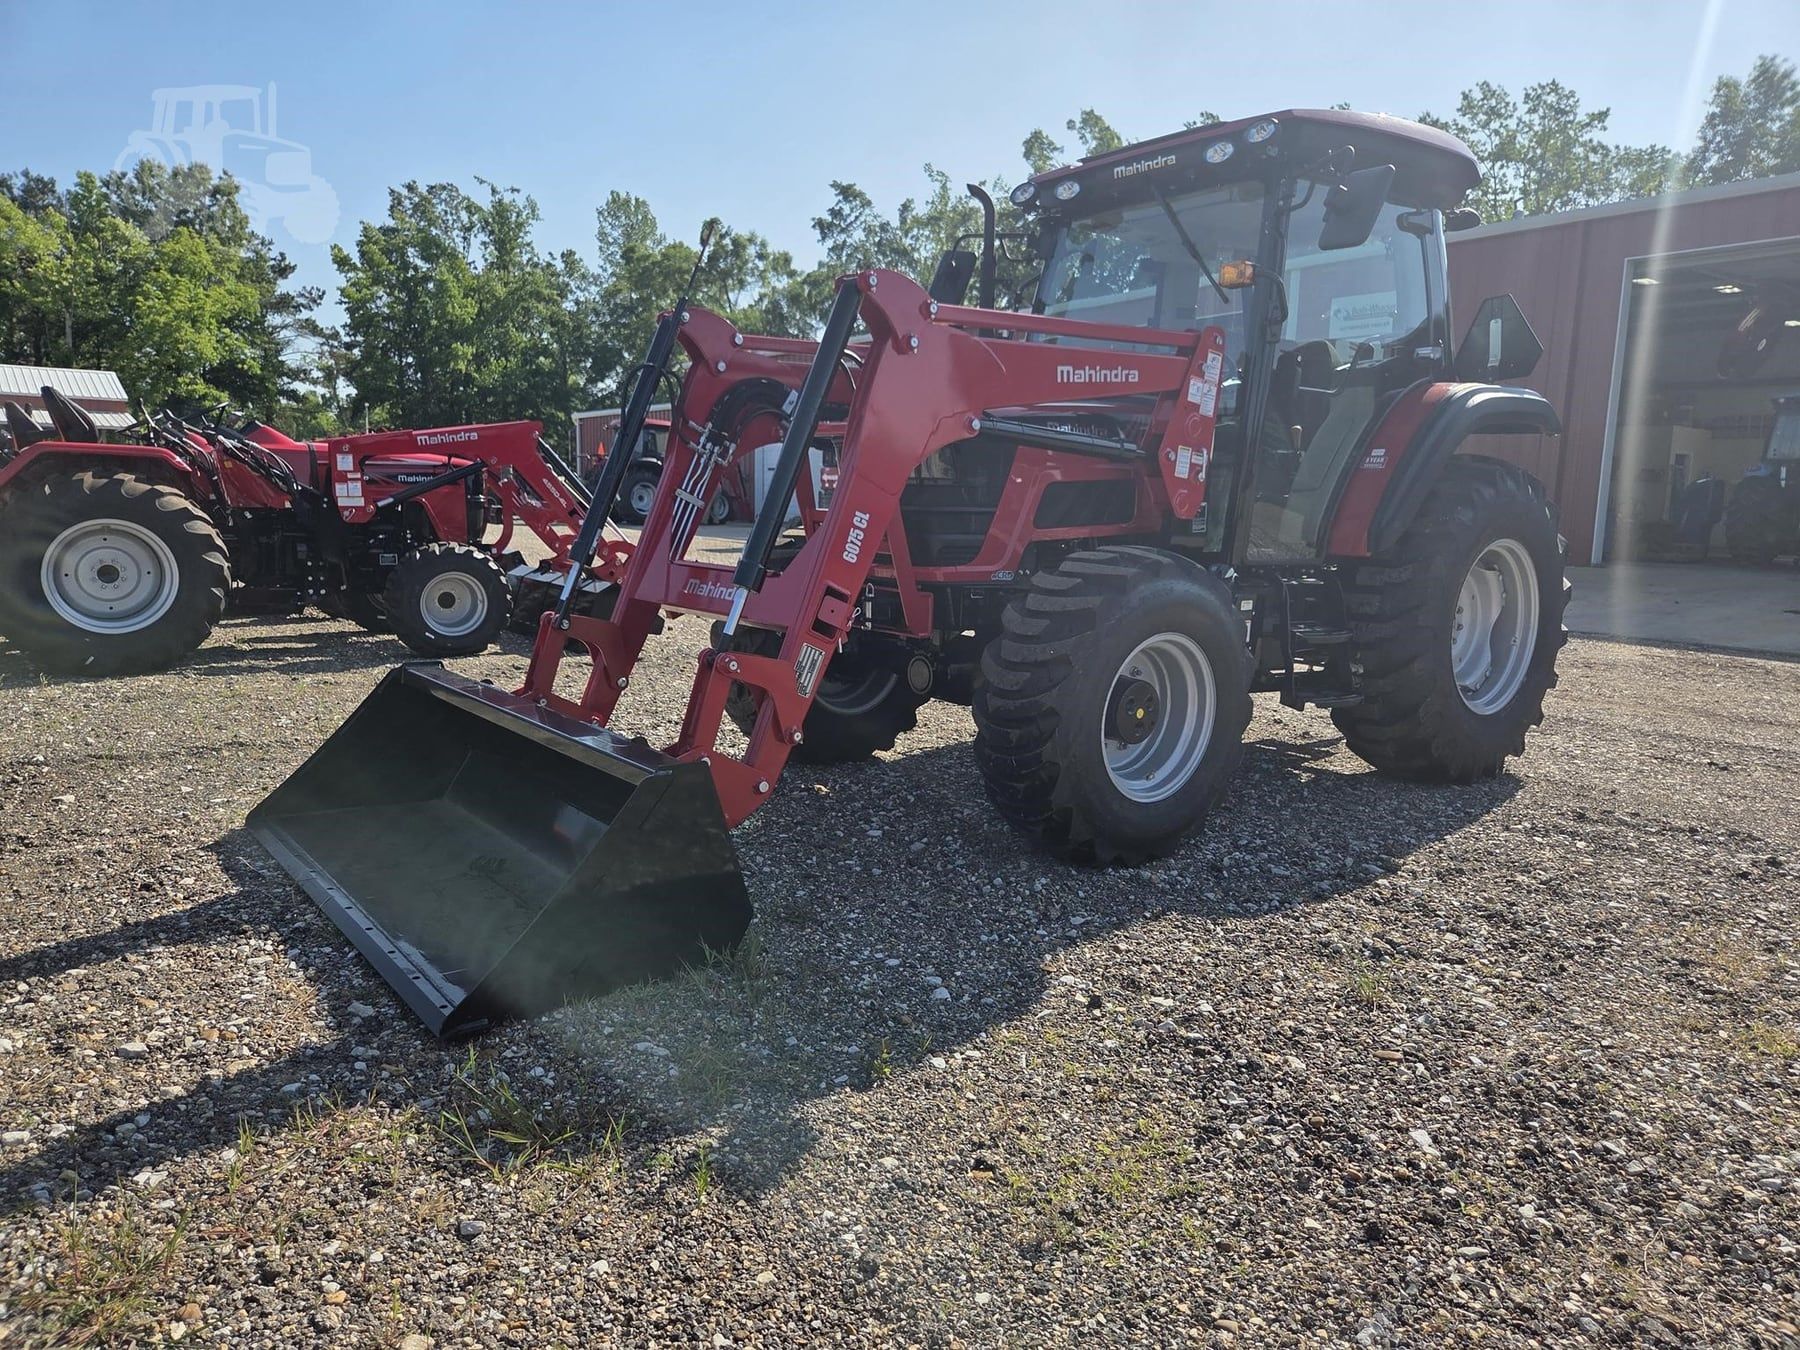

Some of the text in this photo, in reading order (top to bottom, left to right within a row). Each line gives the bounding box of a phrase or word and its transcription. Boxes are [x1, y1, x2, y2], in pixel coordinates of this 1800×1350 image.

[1113, 154, 1176, 179] Mahindra
[1056, 365, 1139, 383] Mahindra
[416, 431, 478, 445] Mahindra
[397, 474, 433, 482] Mahin
[842, 510, 870, 563] 6075 CL
[684, 578, 737, 601] Mahind
